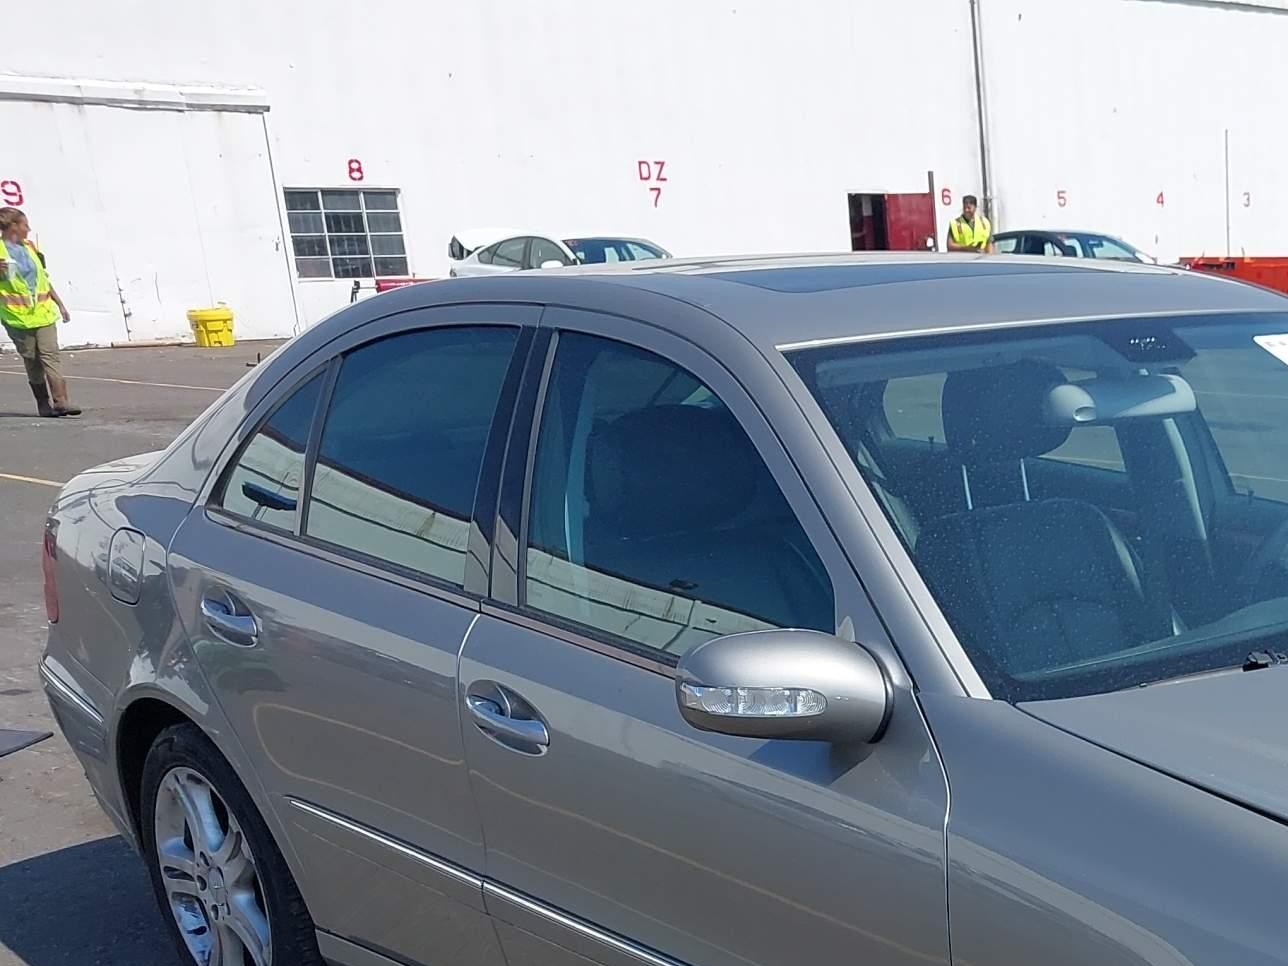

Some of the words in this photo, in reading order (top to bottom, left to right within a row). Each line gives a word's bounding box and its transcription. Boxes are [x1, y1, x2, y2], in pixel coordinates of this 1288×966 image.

[347, 159, 364, 181] 8
[0, 180, 24, 206] 9
[649, 187, 661, 208] 7
[941, 188, 951, 206] 6
[1057, 190, 1067, 207] 5
[1156, 191, 1164, 208] 4
[1243, 191, 1251, 207] 3
